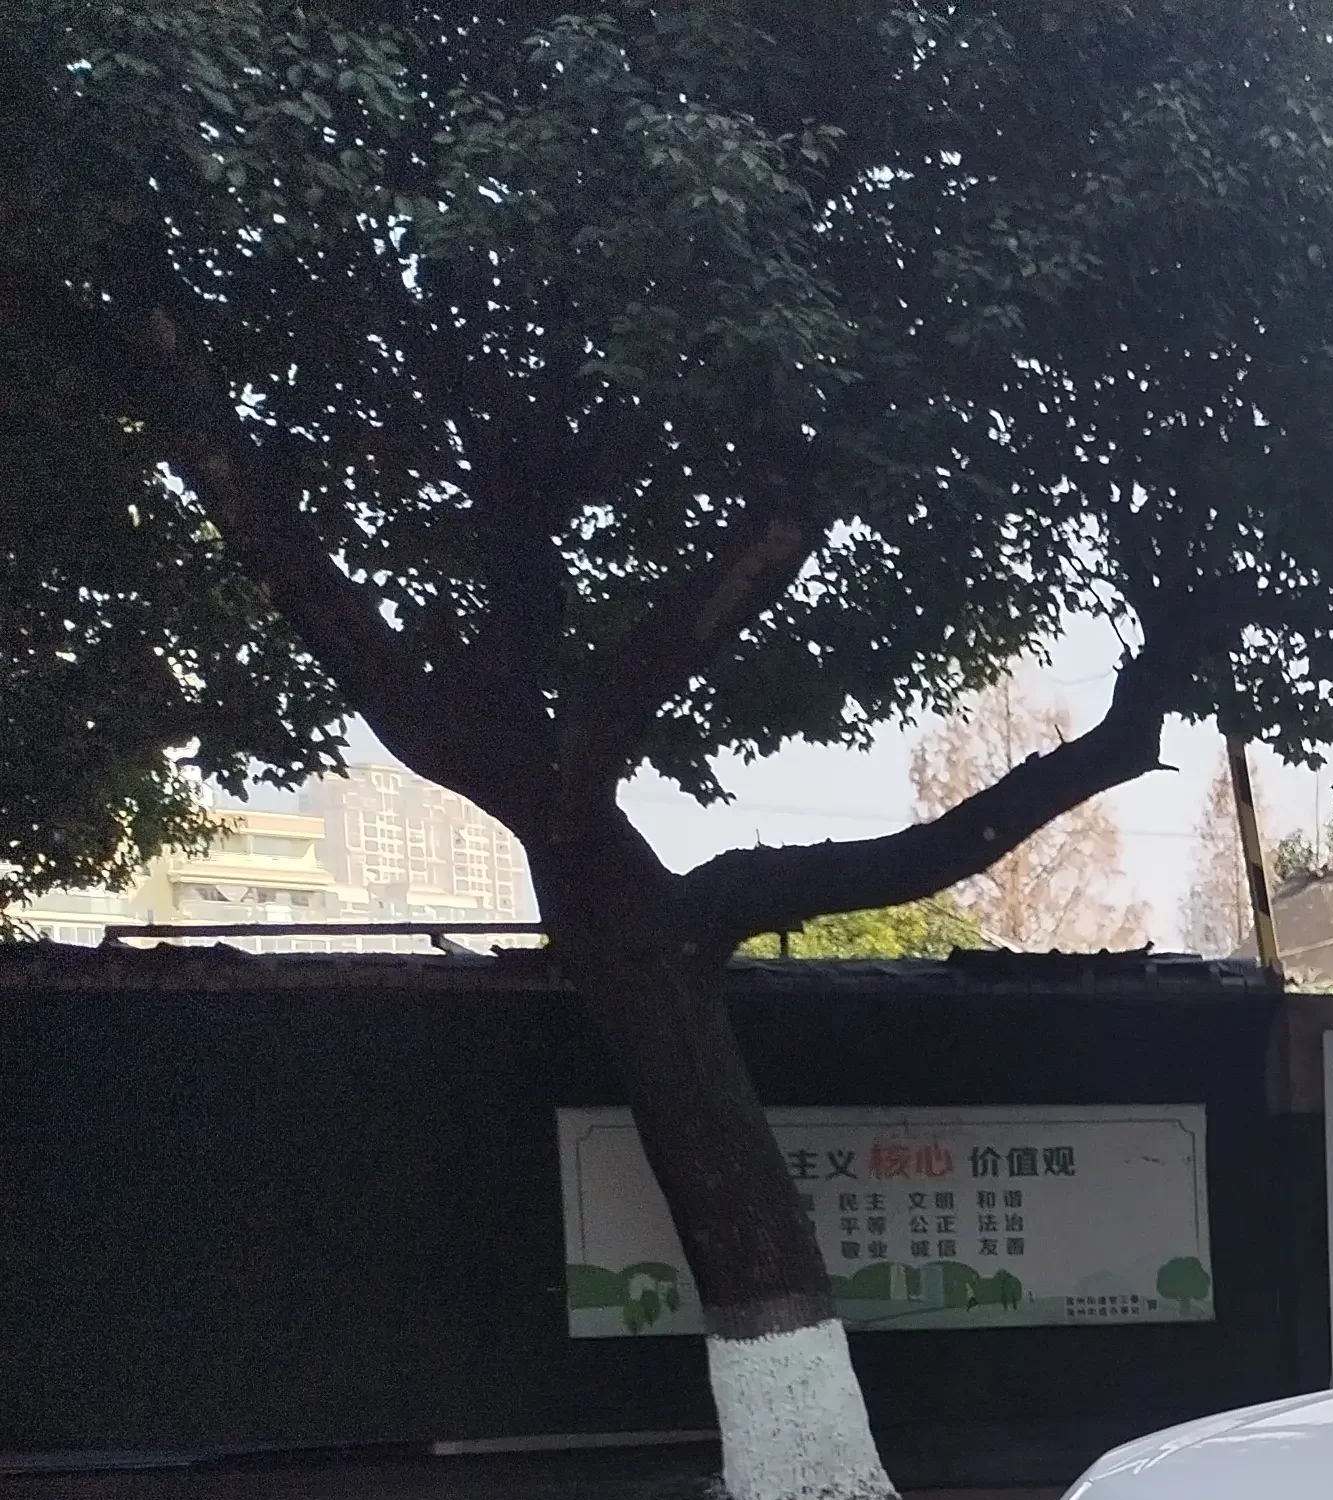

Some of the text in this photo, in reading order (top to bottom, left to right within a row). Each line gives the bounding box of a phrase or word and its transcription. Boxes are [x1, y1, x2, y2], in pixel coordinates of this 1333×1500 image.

[866, 1143, 954, 1180] 核心
[968, 1146, 1077, 1178] 价值观
